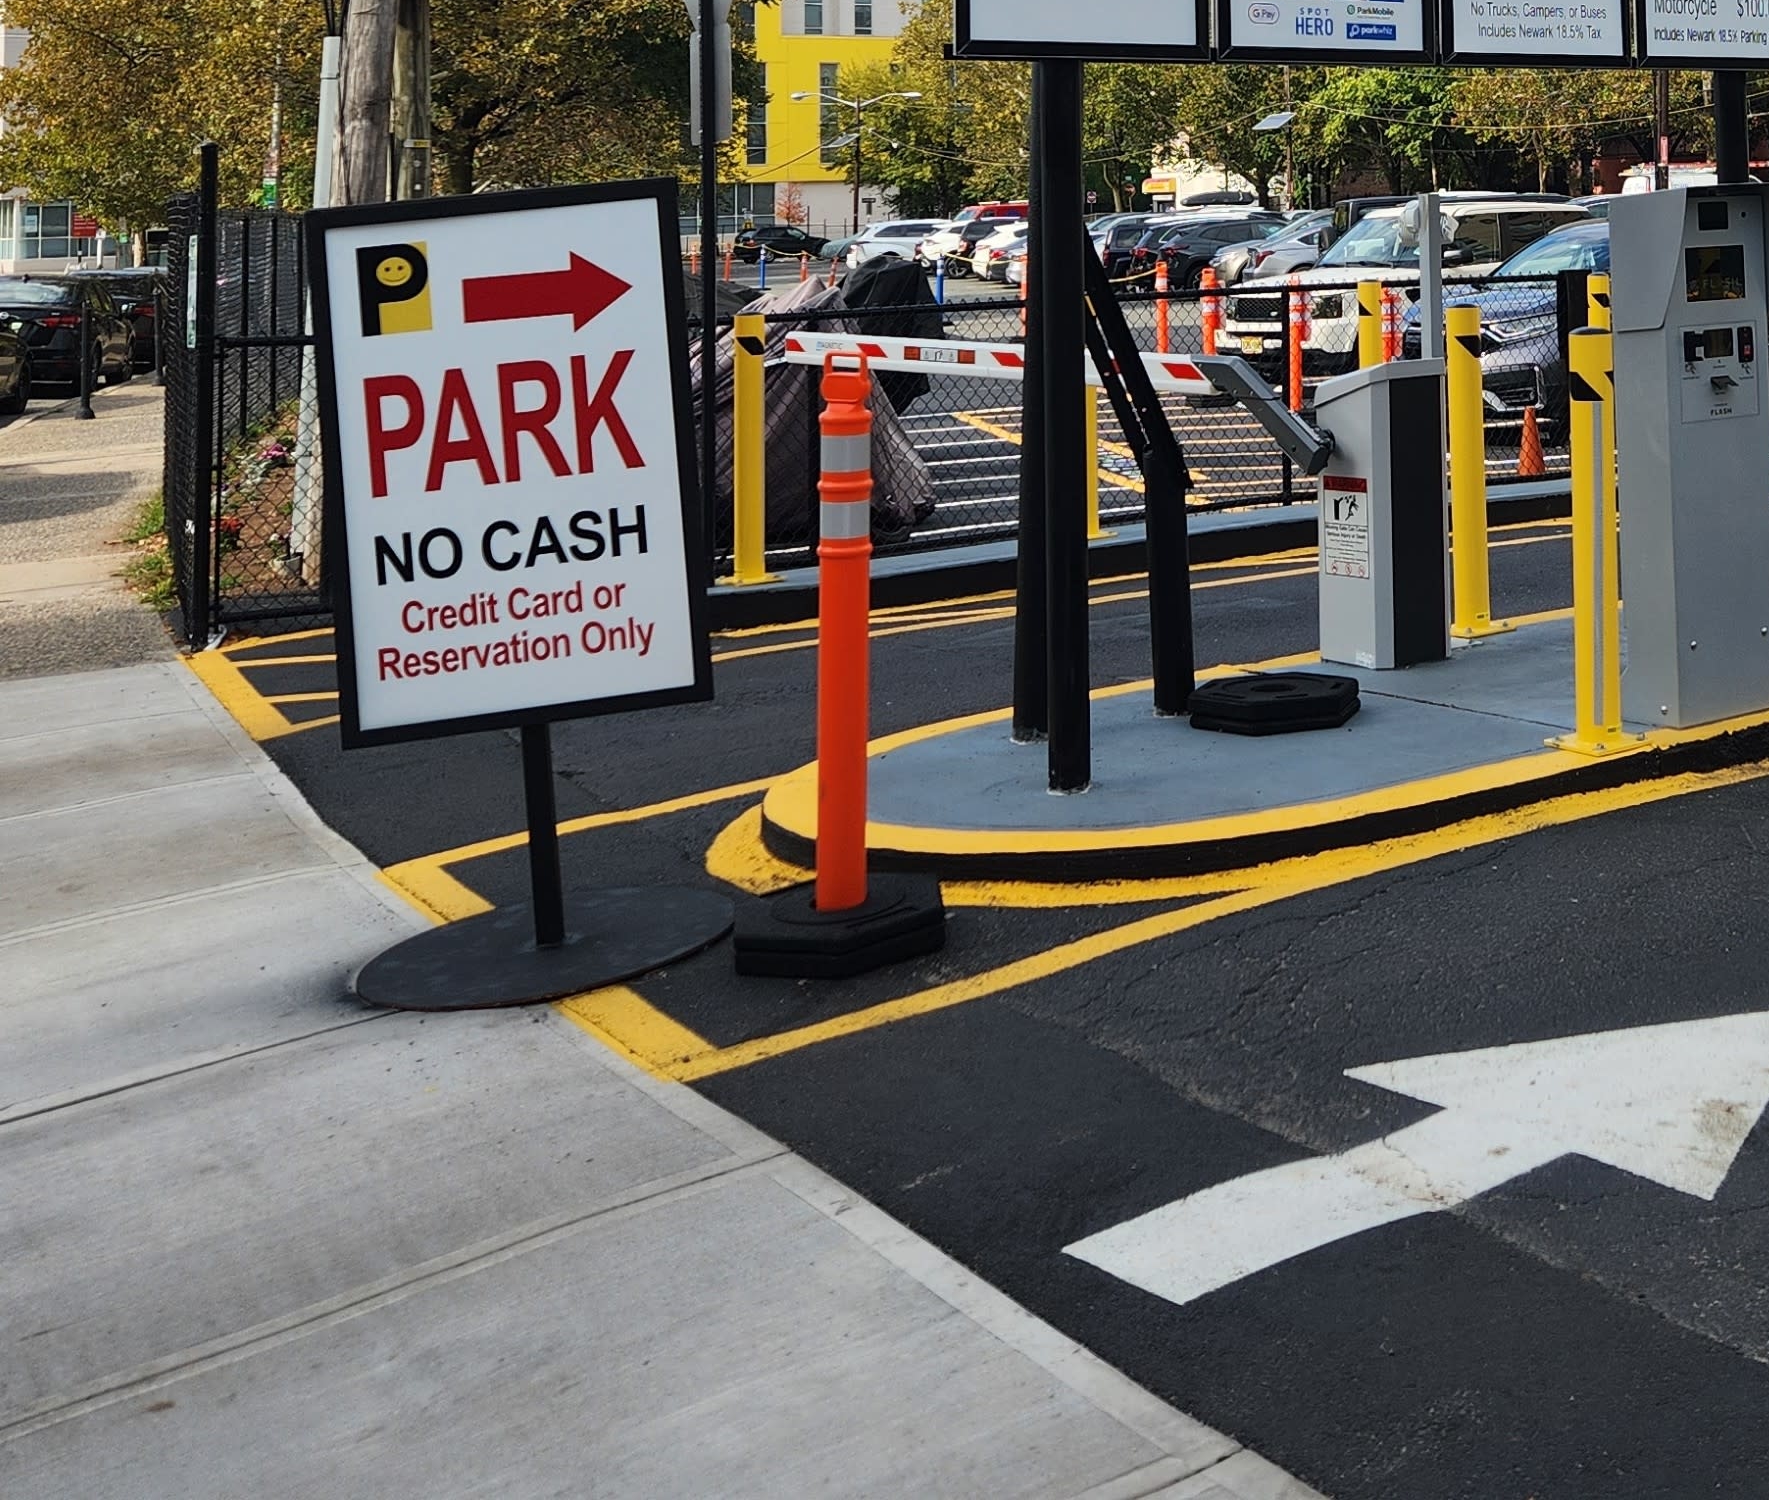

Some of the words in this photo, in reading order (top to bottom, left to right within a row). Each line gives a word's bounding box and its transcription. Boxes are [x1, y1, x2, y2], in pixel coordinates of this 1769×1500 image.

[1253, 8, 1260, 18] G
[1262, 9, 1275, 20] Pay
[1300, 8, 1329, 16] SPOT
[1357, 7, 1394, 15] ParkMobile
[1471, 2, 1483, 16] No
[1569, 7, 1578, 16] or
[1581, 5, 1606, 19] Buses
[1296, 17, 1333, 36] HERO
[1479, 24, 1516, 38] Includes
[1519, 24, 1552, 38] Newark
[1557, 25, 1584, 39] 18.5%
[1587, 25, 1601, 39] Tax
[1654, 28, 1684, 42] Includes
[1687, 28, 1715, 42] Newark
[1741, 30, 1767, 45] Parking
[363, 349, 645, 498] PARK
[374, 527, 462, 586] NO
[482, 504, 648, 571] CASH
[401, 594, 498, 634] Credit
[508, 584, 583, 619] Card
[594, 583, 626, 609] or
[378, 628, 569, 681] Reservation
[581, 617, 654, 657] Only
